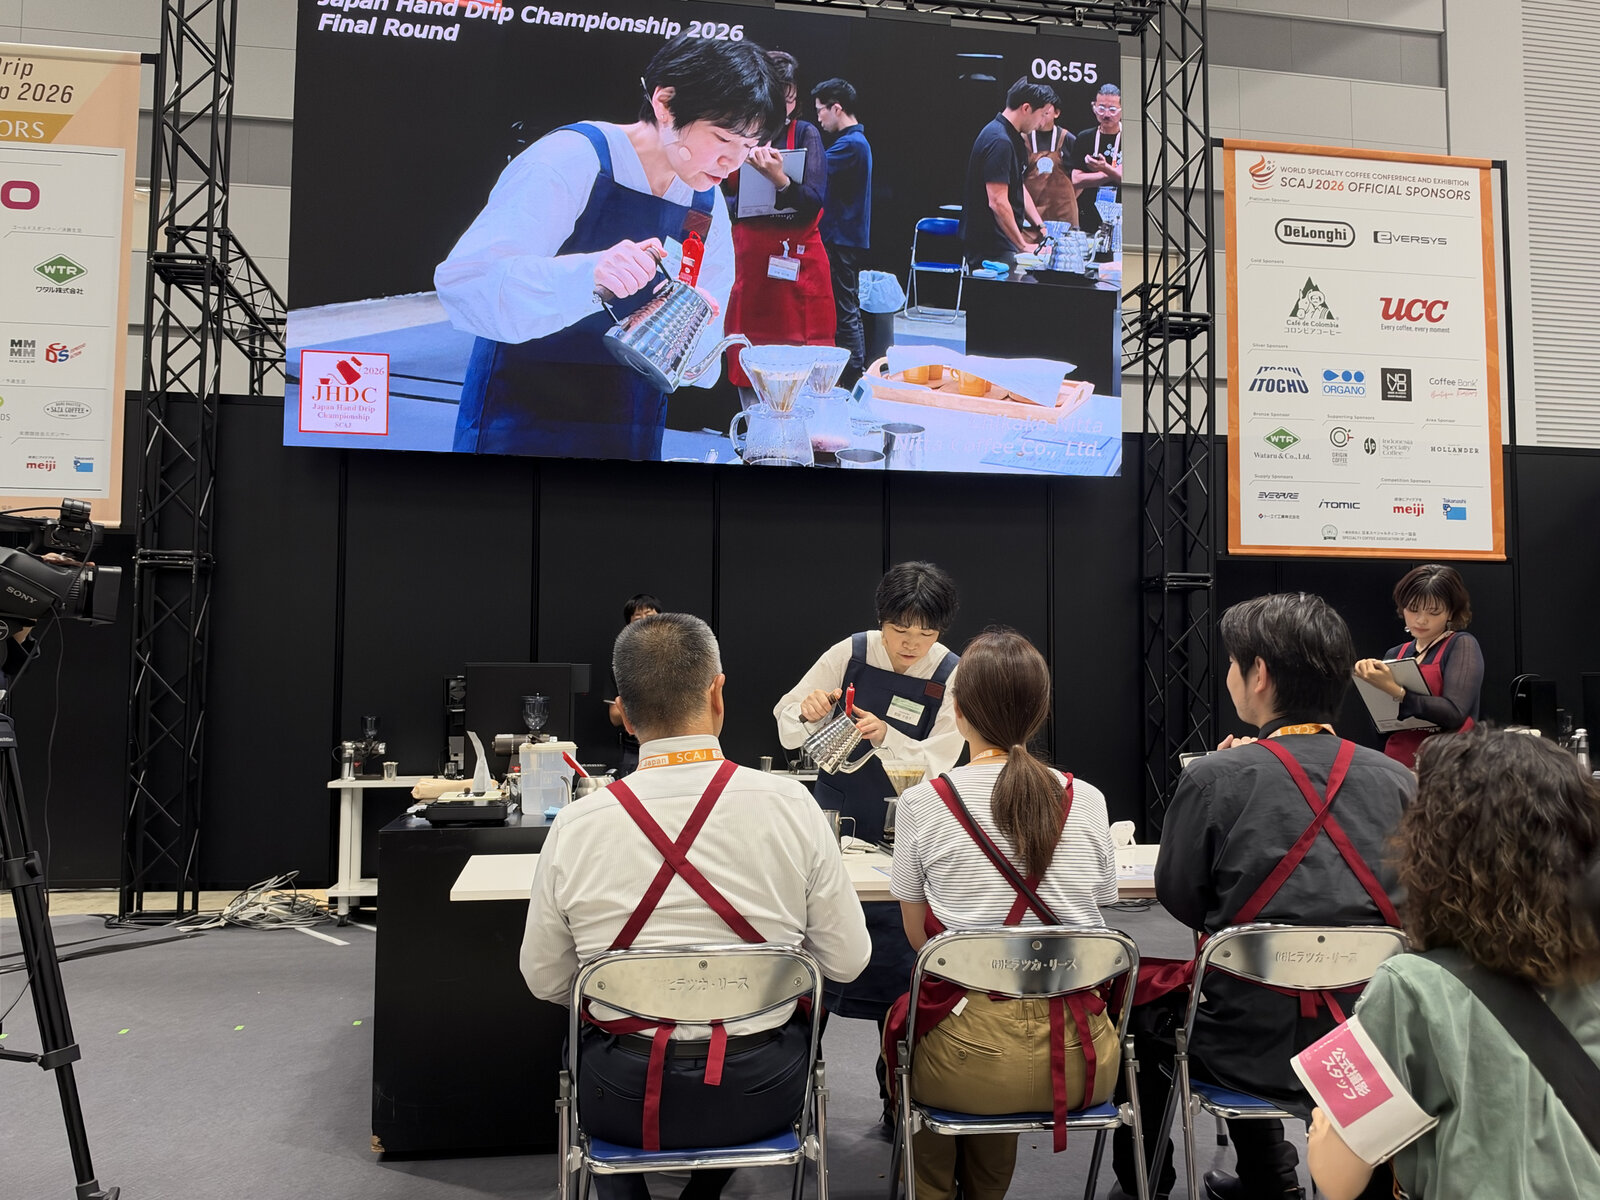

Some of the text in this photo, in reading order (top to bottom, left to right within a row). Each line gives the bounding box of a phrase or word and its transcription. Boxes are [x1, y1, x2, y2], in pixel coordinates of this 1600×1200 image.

[396, 0, 458, 17] Hand
[464, 1, 514, 24] Drip
[520, 6, 681, 39] Championship
[686, 21, 744, 42] 2026
[317, 13, 461, 42] Final Round
[0, 57, 34, 80] rip
[1031, 58, 1098, 84] 06:55
[17, 82, 75, 104] 2026
[1280, 166, 1470, 187] WORLD SPECIALTY COFFEE CONFERENCE AND EXHIBITION
[1347, 182, 1402, 196] OFFICIAL
[1405, 186, 1471, 201] SPONSORS
[43, 265, 78, 275] WTR
[35, 286, 84, 295] ワタル株式会社
[1302, 319, 1309, 327] de
[1310, 320, 1339, 328] Colombia
[1381, 323, 1395, 332] Every
[1284, 327, 1342, 336] コロンビアコーヒー
[363, 366, 385, 376] 2026
[1248, 378, 1310, 394] ITOCHU
[1429, 377, 1456, 386] Coffee
[311, 385, 377, 404] JHDC
[1323, 385, 1366, 395] ORGANO
[312, 403, 376, 414] Japan Hand Drip
[317, 412, 371, 422] Championship
[1270, 435, 1294, 444] WTR
[1021, 440, 1057, 458] Co.,
[1065, 440, 1102, 457] Ltd.
[1382, 444, 1412, 453] Specialty
[1430, 446, 1480, 454] HOLLANDER
[1254, 451, 1278, 460] Wataru
[26, 460, 56, 472] meiji
[1392, 503, 1425, 517] meiji
[5, 585, 38, 604] SONY
[643, 756, 667, 767] Japan
[676, 750, 707, 763] SCAJ
[1321, 1055, 1358, 1100] スタッフ
